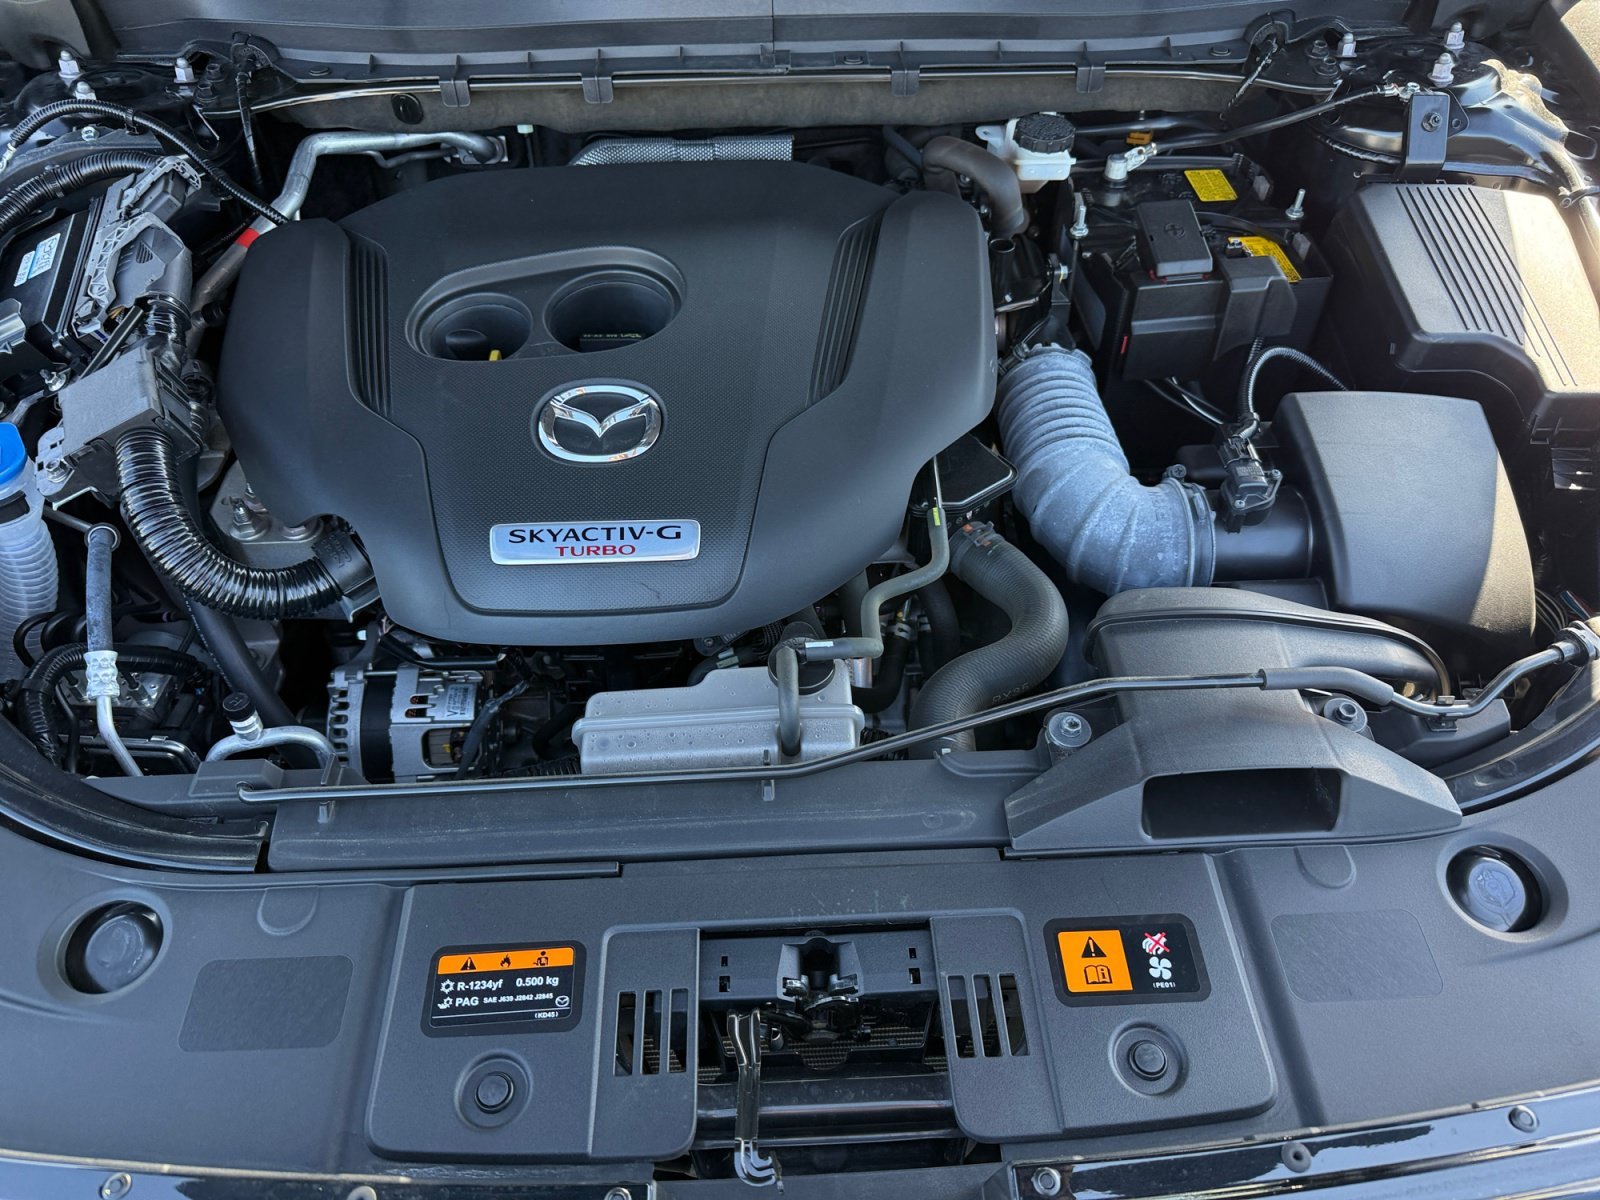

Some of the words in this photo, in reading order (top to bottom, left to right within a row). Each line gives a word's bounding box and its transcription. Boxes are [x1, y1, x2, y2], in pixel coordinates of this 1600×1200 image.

[508, 525, 682, 544] SKYACTIV-G
[555, 544, 636, 557] TURBO
[457, 979, 504, 991] R-1234yf
[516, 977, 544, 987] 0.500
[546, 976, 559, 986] kg
[455, 996, 479, 1007] PAG
[483, 996, 498, 1004] SAE
[498, 995, 514, 1003] J639
